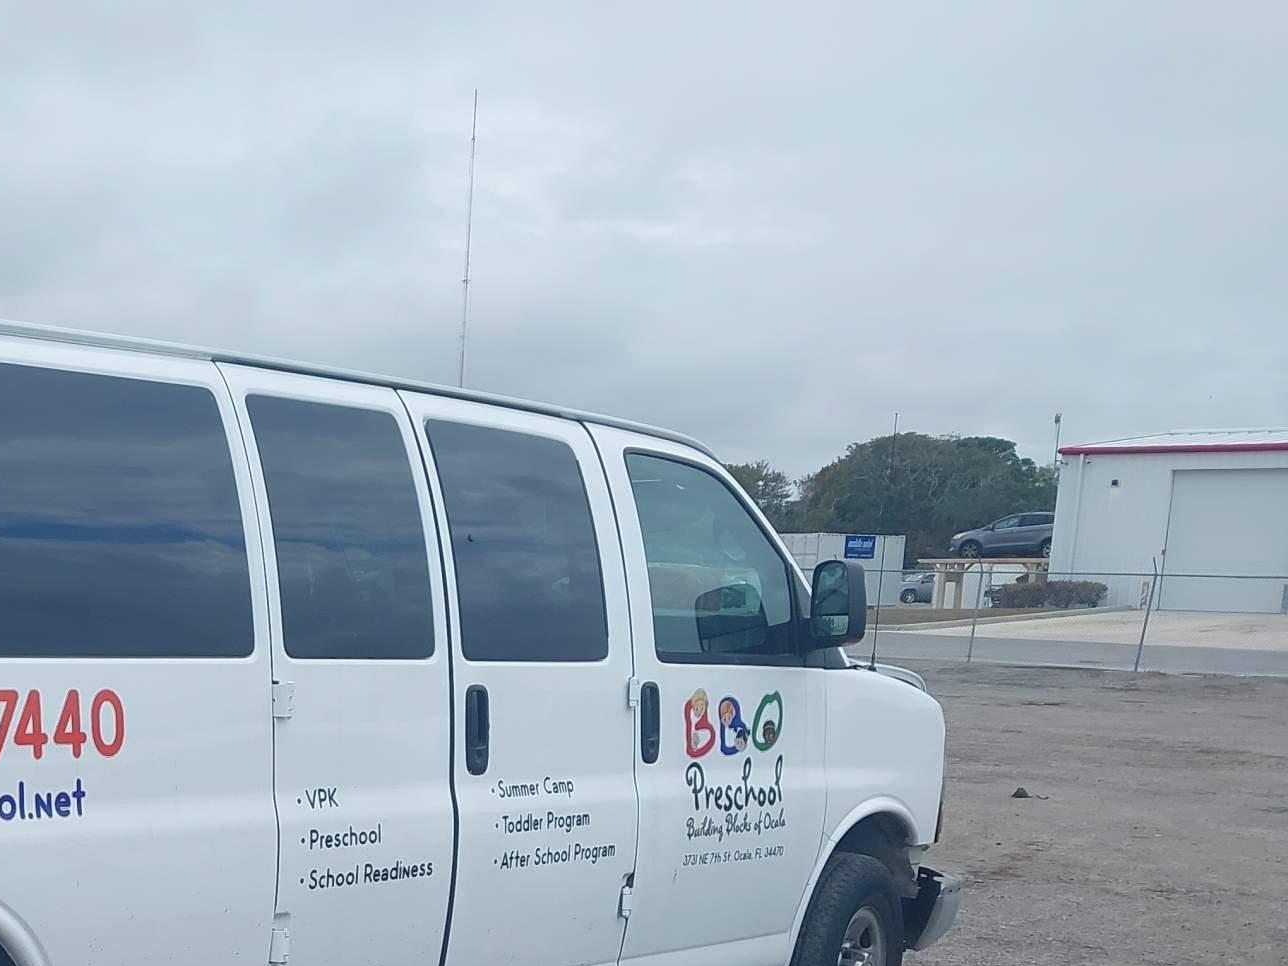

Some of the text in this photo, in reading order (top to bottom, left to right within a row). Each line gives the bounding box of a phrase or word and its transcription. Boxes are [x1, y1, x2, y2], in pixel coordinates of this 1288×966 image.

[497, 777, 574, 800] Summer Camp
[685, 754, 784, 811] Preschool
[305, 787, 340, 810] VPK
[502, 810, 591, 835] Toddler Program
[686, 807, 786, 843] Building Blocks of Ocala
[309, 824, 382, 851] Preschool
[500, 841, 617, 871] After School Program
[698, 853, 709, 865] NE
[710, 852, 721, 864] 7th
[754, 847, 762, 859] FL
[764, 846, 784, 857] 34470
[308, 865, 360, 891] School
